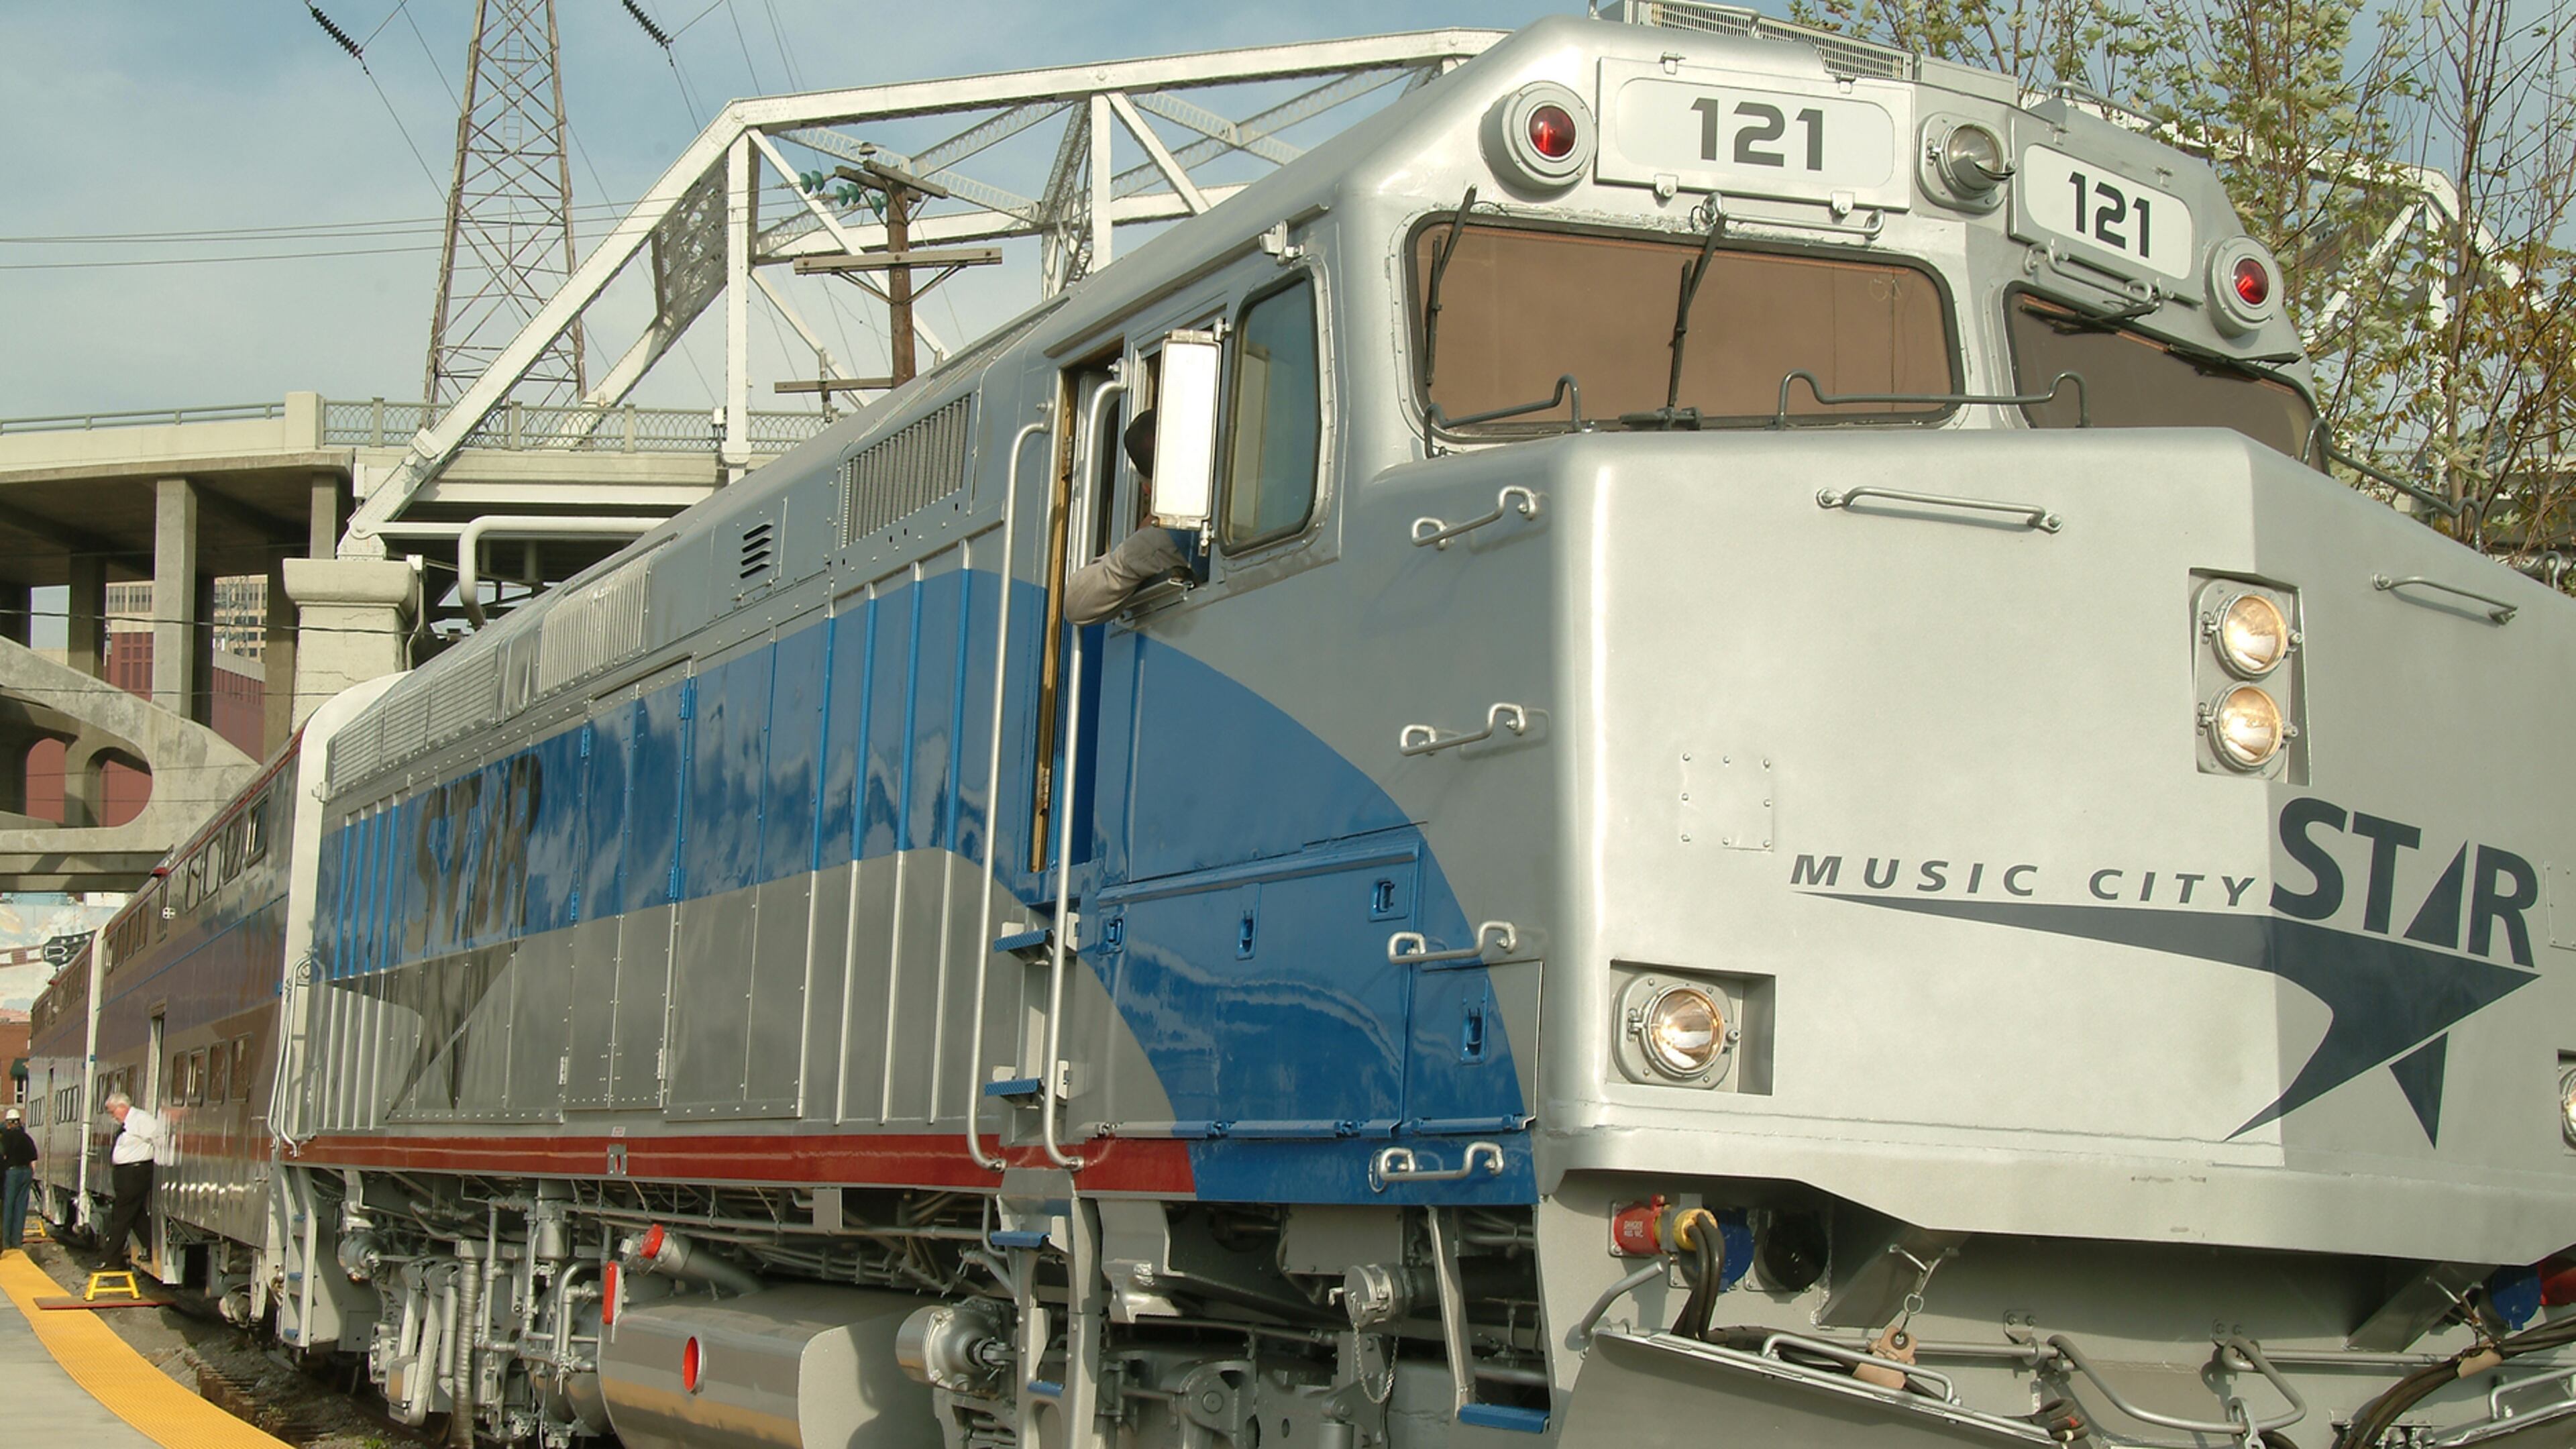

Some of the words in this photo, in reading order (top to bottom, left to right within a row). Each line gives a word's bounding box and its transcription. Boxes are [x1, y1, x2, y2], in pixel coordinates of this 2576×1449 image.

[1690, 96, 1823, 172] 121
[2068, 170, 2151, 259] 121
[404, 753, 543, 954] STAR
[1789, 854, 2039, 897] MUSIC
[2088, 868, 2256, 908] CITY
[2269, 796, 2538, 969] STAR
